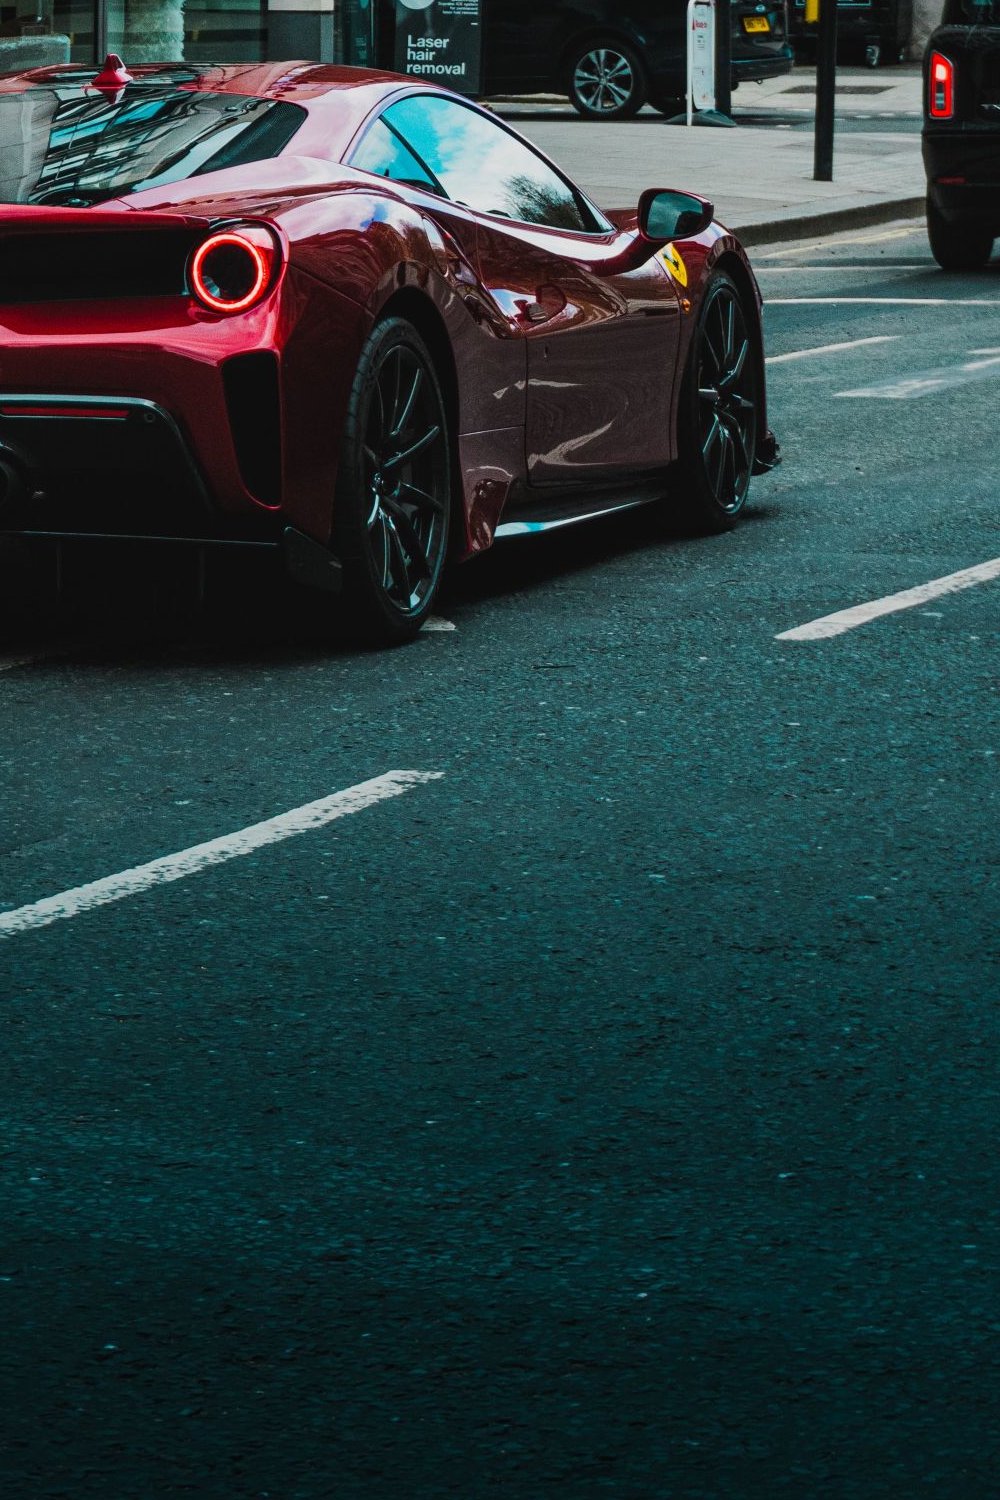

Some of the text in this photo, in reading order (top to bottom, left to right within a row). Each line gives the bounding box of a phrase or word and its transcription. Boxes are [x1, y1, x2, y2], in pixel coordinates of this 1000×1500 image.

[407, 35, 449, 48] Laser
[407, 48, 436, 61] hair
[406, 62, 466, 75] removal
